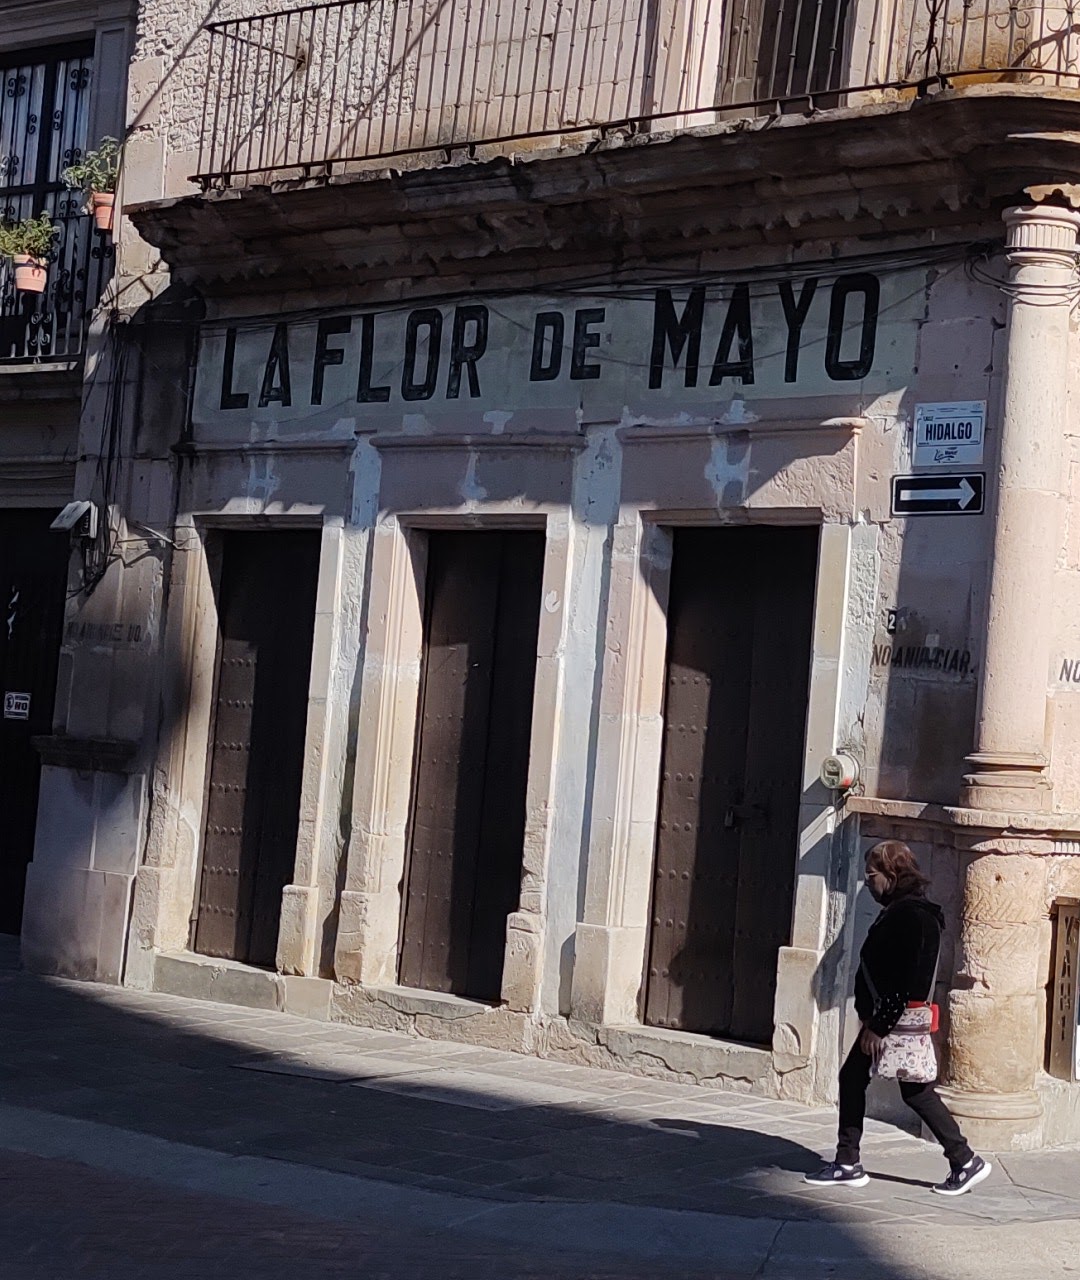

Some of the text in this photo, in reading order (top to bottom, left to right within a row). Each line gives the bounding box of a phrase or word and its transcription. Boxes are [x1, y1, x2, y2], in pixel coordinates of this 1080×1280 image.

[219, 271, 882, 410] LA FLOR DE MAYO
[925, 421, 973, 441] HIDALGO
[870, 643, 893, 669] NO
